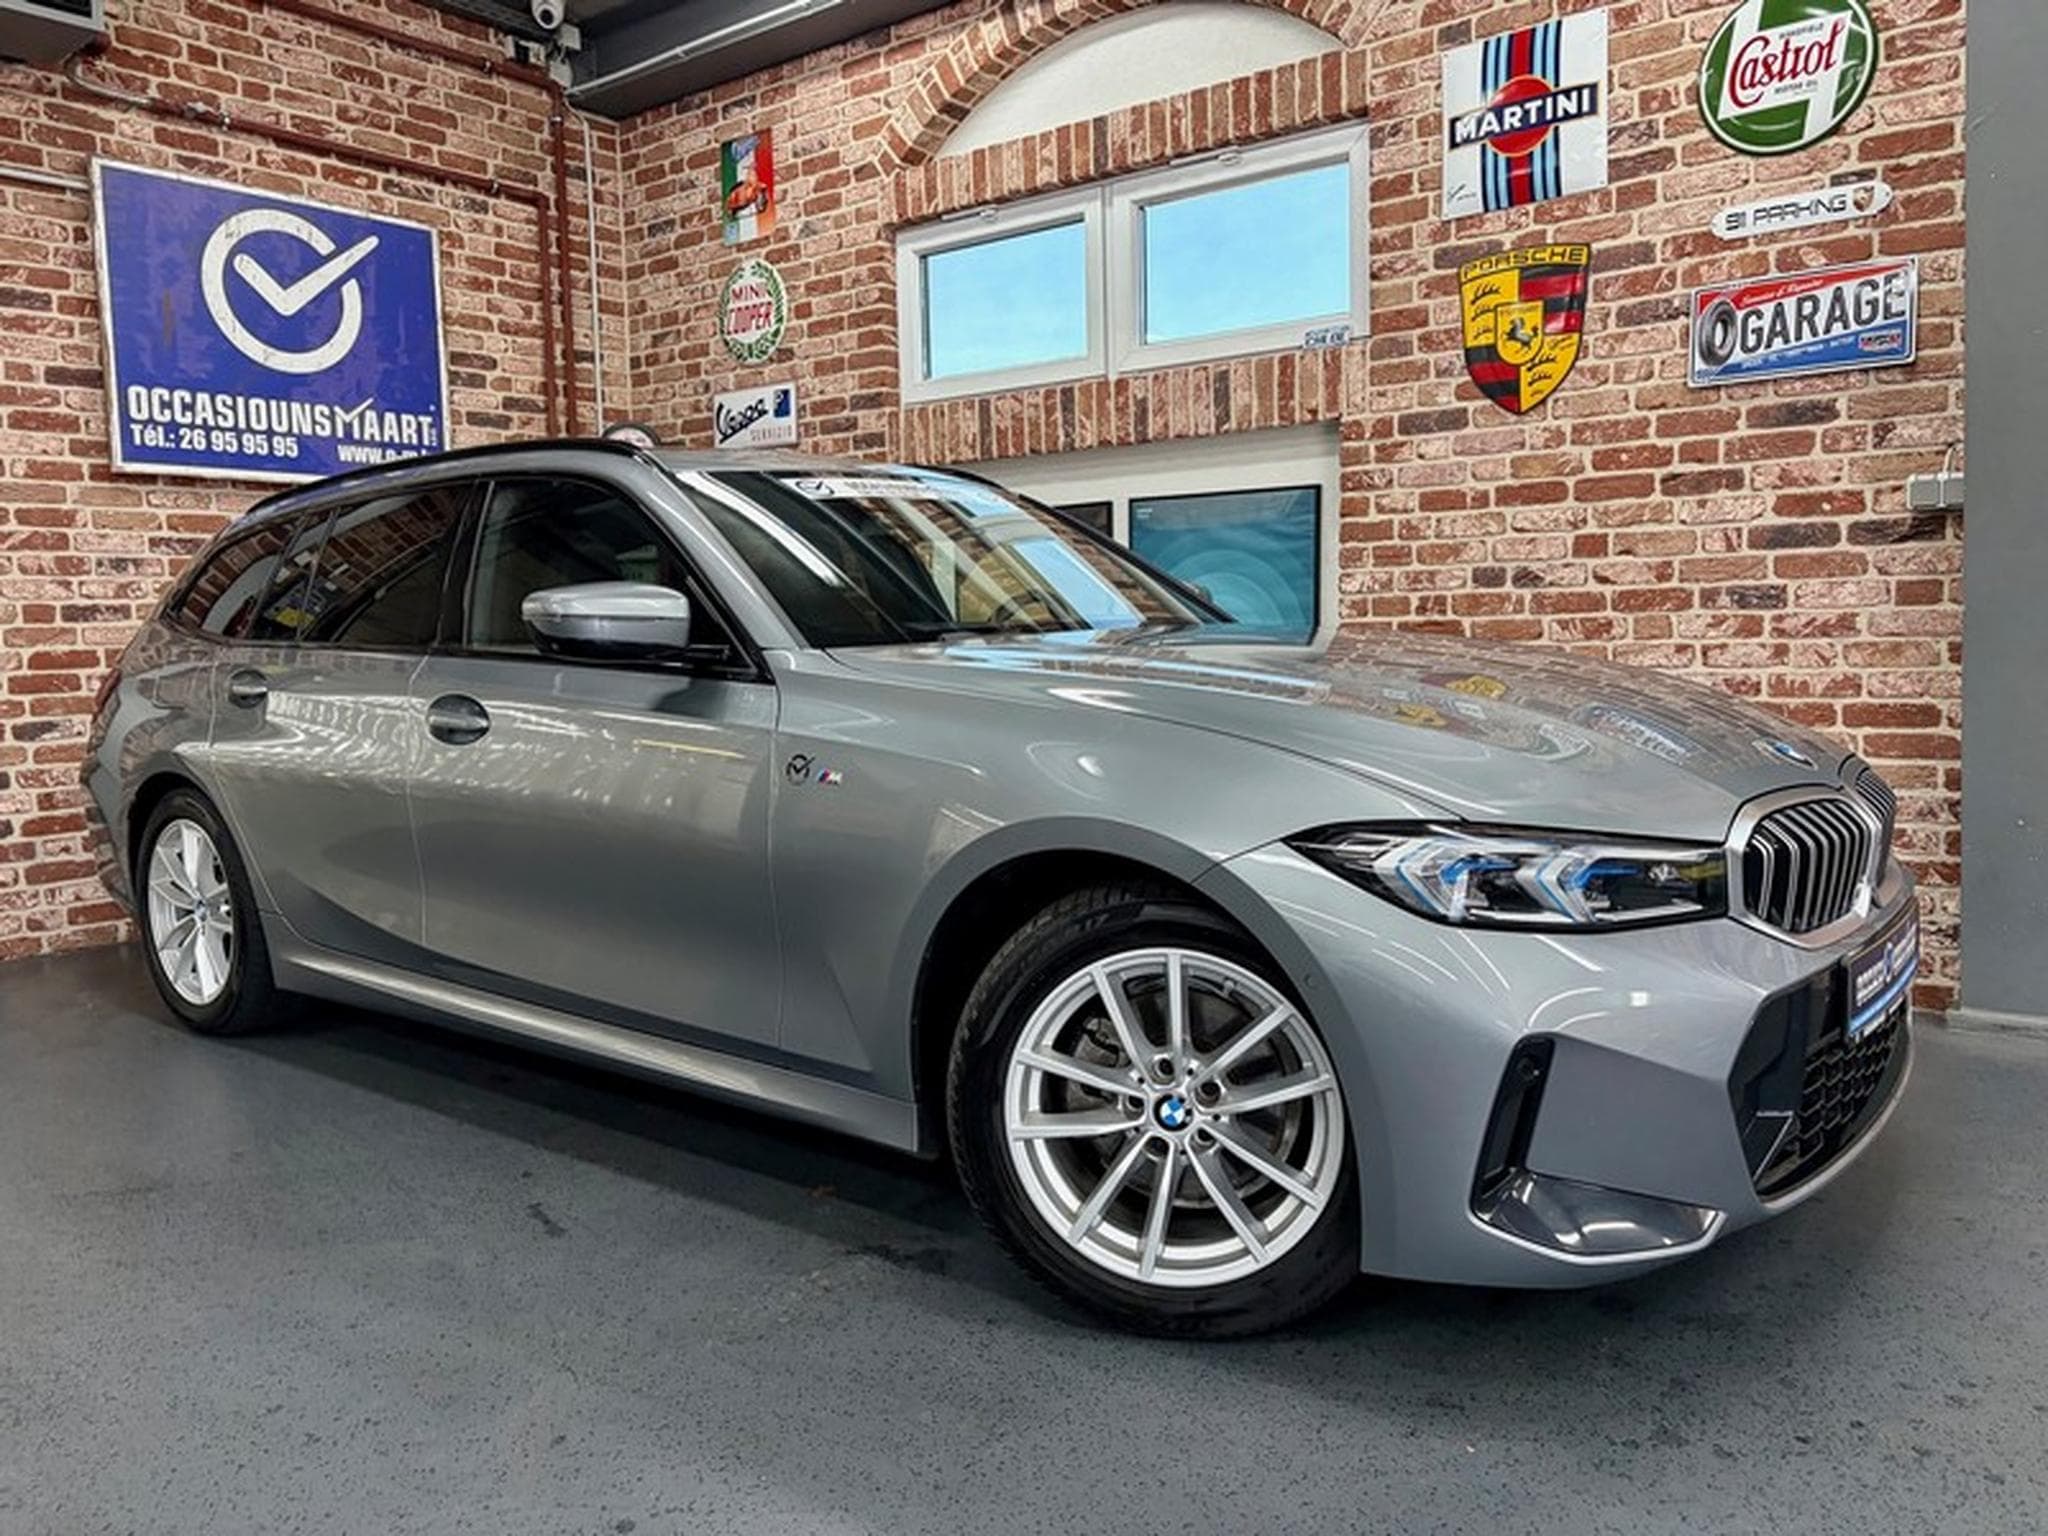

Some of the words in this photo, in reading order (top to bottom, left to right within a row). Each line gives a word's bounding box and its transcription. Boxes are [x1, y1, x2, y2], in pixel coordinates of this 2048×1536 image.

[1728, 18, 1845, 109] Castrol
[1455, 88, 1591, 144] MARTINI
[1753, 193, 1847, 226] PARKING
[1463, 246, 1585, 280] PORSCHE
[727, 301, 772, 335] COOPER
[1740, 271, 1906, 354] GARAGE
[127, 384, 433, 446] OCCASIOUNSMAART
[130, 423, 175, 449] Tél.:
[179, 427, 206, 451] 26
[211, 430, 238, 453] 95
[242, 432, 269, 456] 95
[272, 435, 298, 458] 95
